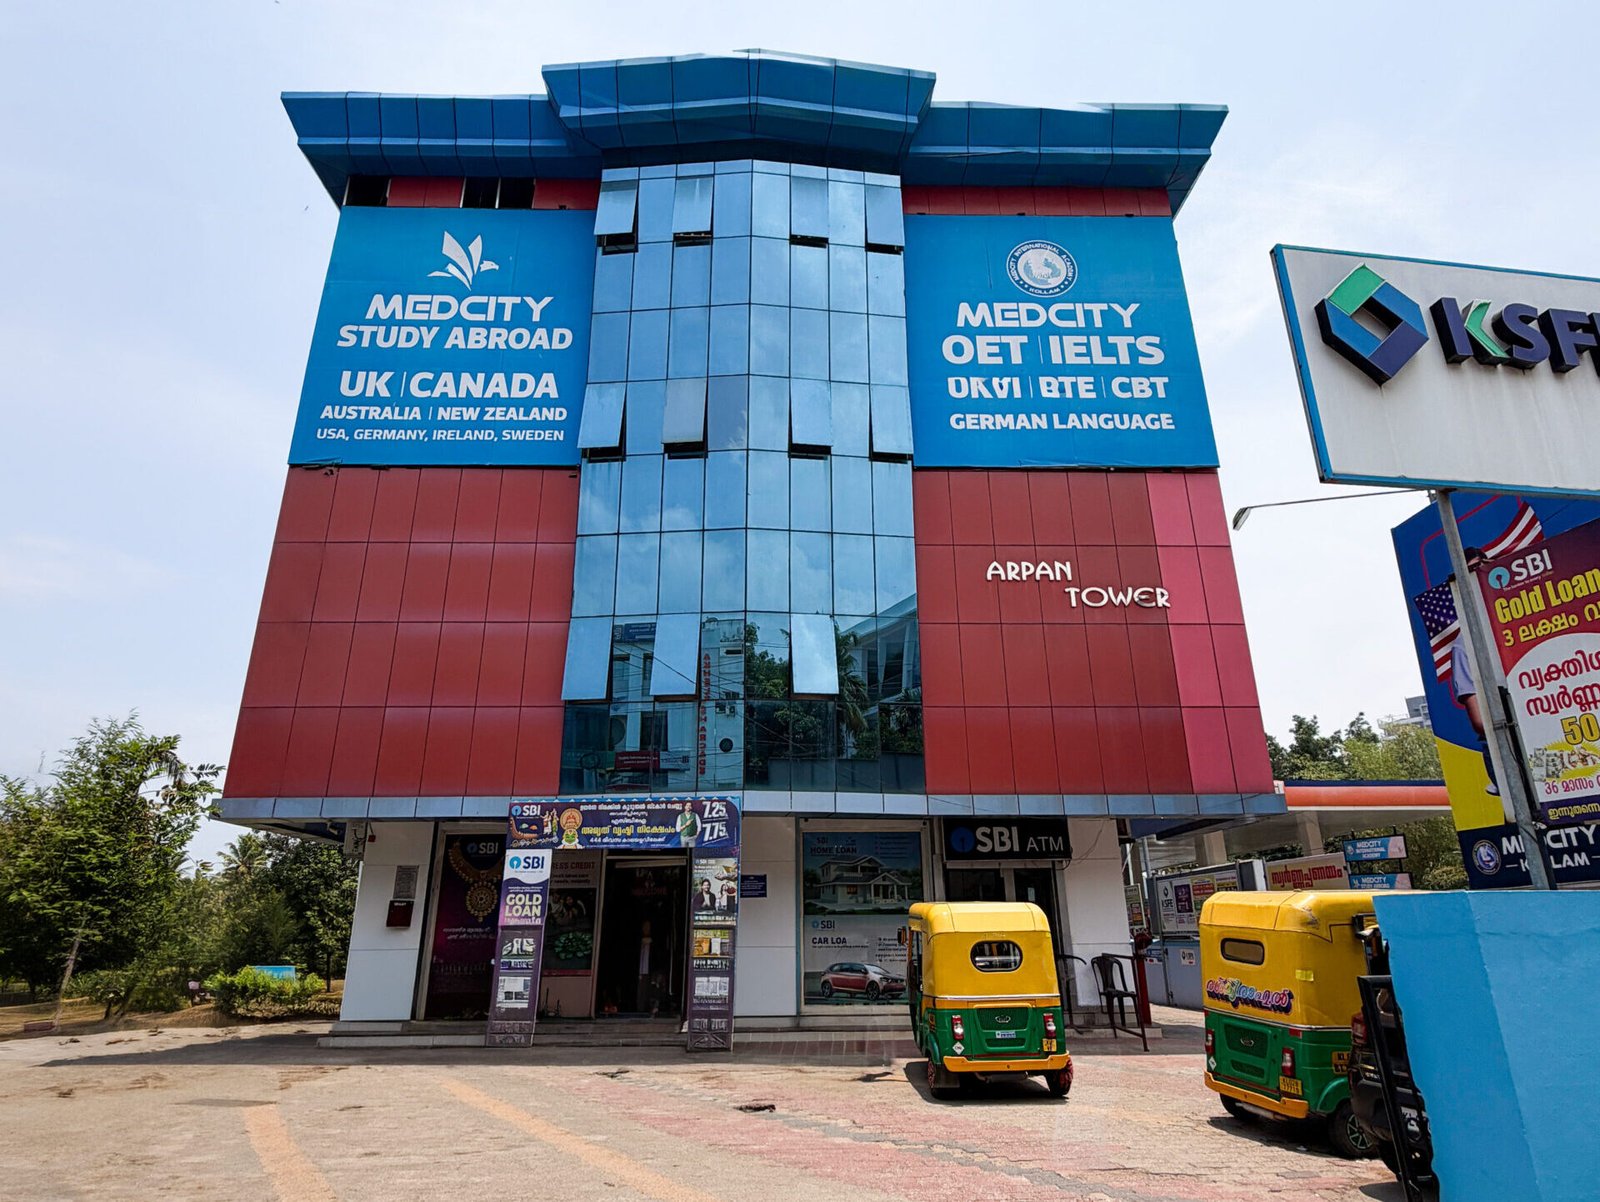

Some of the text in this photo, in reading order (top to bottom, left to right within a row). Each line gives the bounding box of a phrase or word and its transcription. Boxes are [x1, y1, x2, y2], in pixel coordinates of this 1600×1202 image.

[365, 294, 554, 322] MEDCITY
[956, 302, 1140, 328] MEDCITY
[337, 325, 573, 350] STUDY ABROAD
[1430, 297, 1600, 374] KSF
[942, 335, 1165, 365] OET IELTS
[339, 371, 559, 398] UK CANADA
[1111, 377, 1169, 399] CBT
[320, 405, 568, 421] AUSTRALIA NEW ZEALAND
[950, 413, 1175, 430] GERMAN LANGUAGE
[316, 429, 564, 442] USA, GERMANY, IRELAND, SWEDEN
[986, 560, 1072, 581] ARPAN
[1511, 548, 1552, 581] SBI
[1064, 586, 1171, 608] TOWER
[1494, 568, 1600, 624] Gold Loan
[1502, 629, 1515, 647] 3
[1518, 612, 1579, 643] ലക്ഷം
[1545, 777, 1594, 795] 36 മാസം
[522, 804, 541, 816] SBI
[478, 842, 499, 855] SBI
[975, 825, 1064, 852] SBI ATM
[1502, 824, 1597, 855] MCITY
[523, 856, 545, 869] SBI
[1521, 851, 1590, 872] KLAM
[506, 893, 542, 905] GOLD
[505, 905, 541, 917] LOAN
[820, 920, 835, 929] SBI
